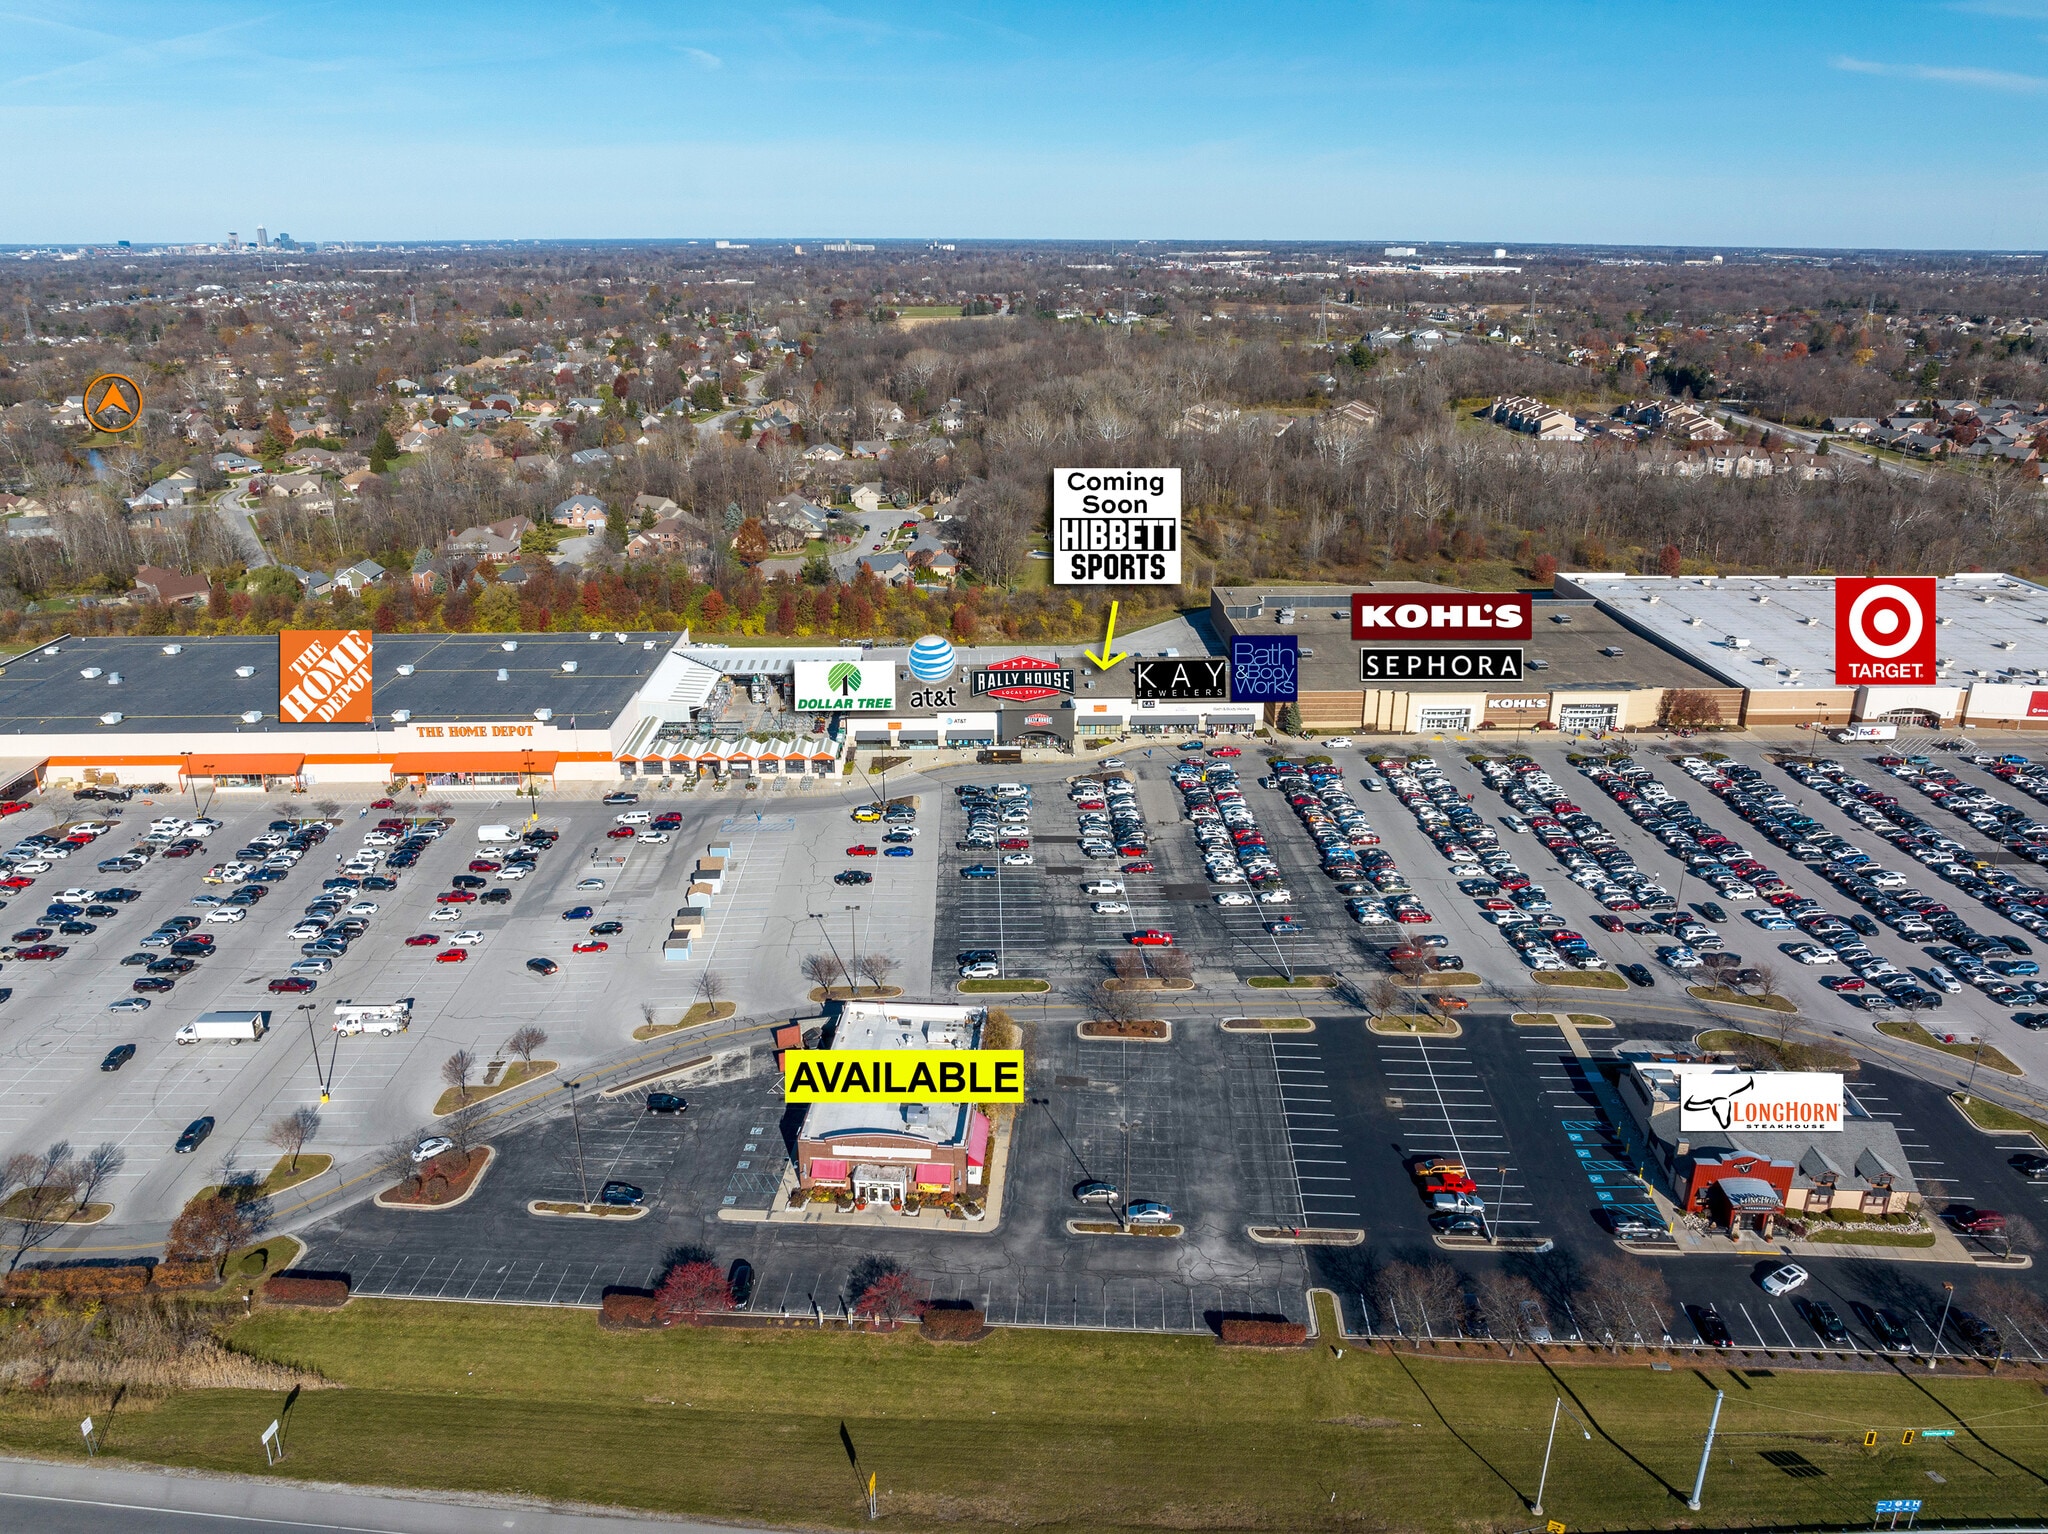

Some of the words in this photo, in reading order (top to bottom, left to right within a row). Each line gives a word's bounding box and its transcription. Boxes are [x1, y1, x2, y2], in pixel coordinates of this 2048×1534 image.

[1488, 698, 1547, 708] KOHL'S
[416, 726, 444, 738] THE
[448, 726, 487, 737] HOME
[491, 725, 534, 737] DEPOT
[1860, 728, 1881, 736] FedEx
